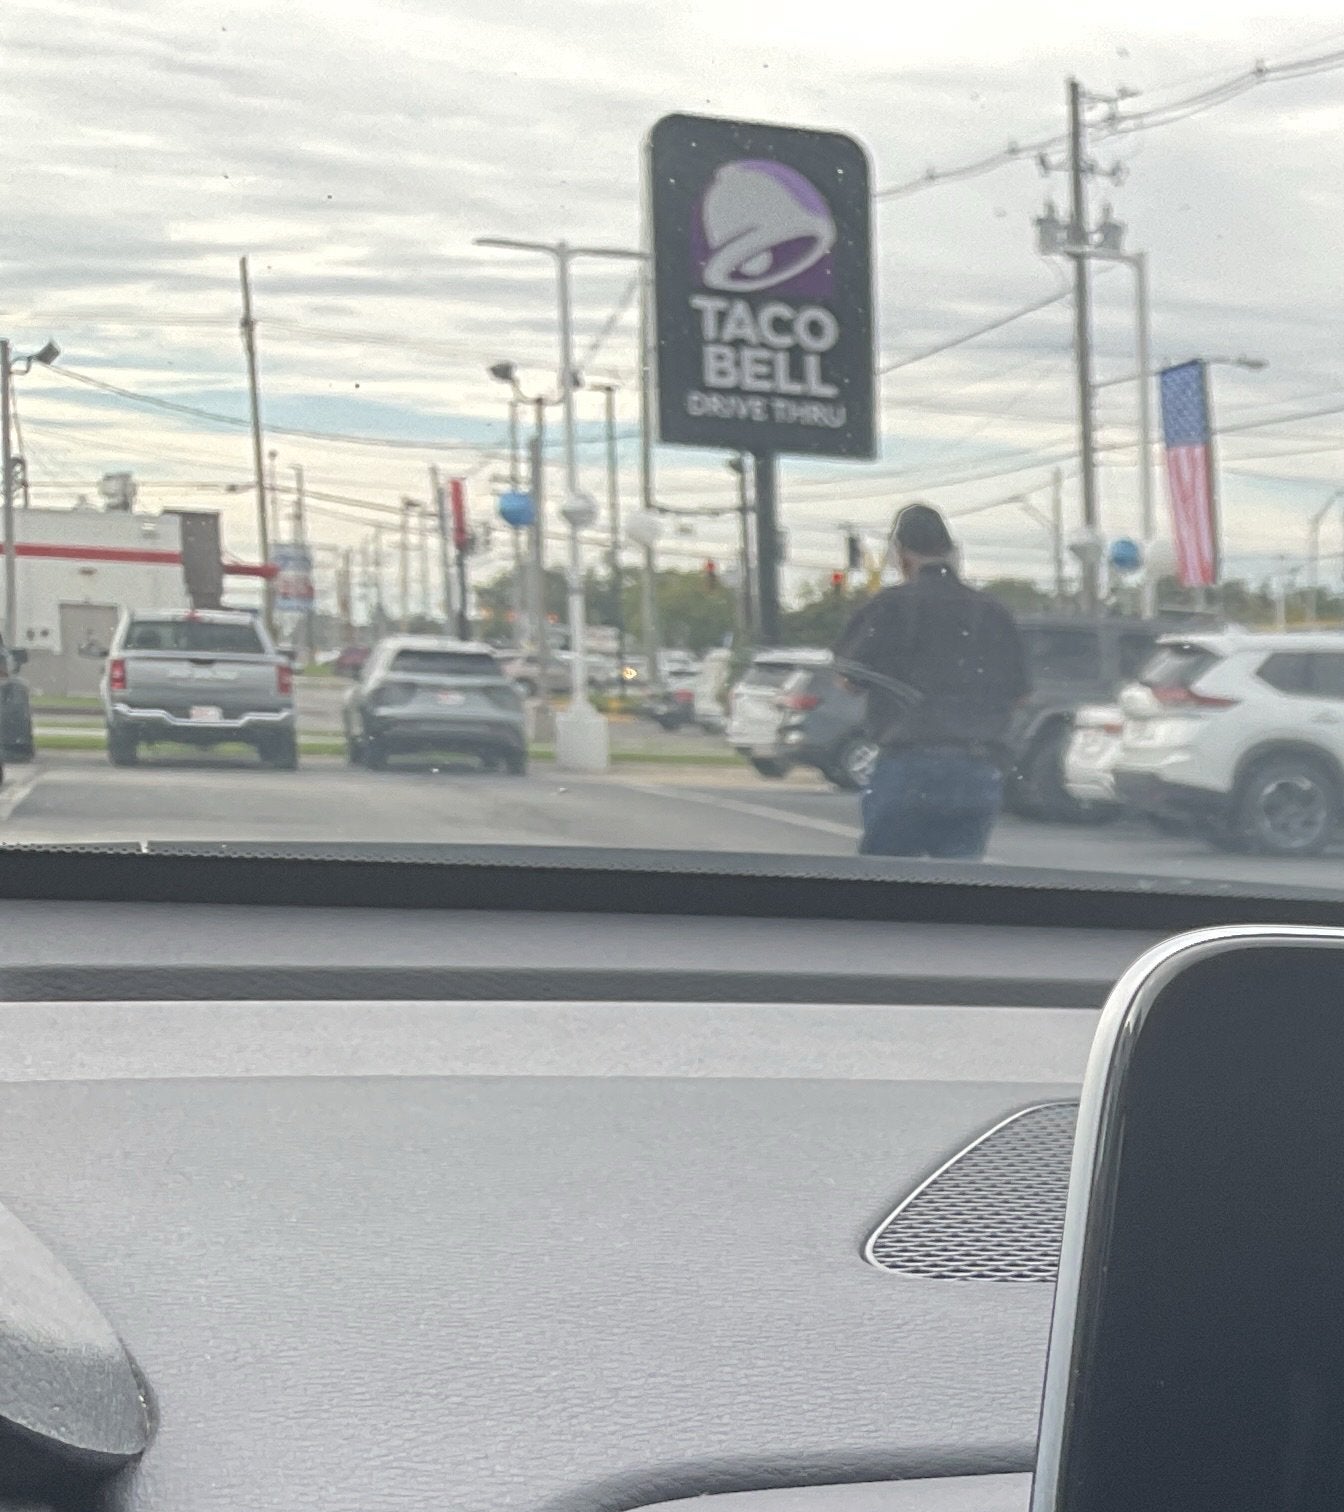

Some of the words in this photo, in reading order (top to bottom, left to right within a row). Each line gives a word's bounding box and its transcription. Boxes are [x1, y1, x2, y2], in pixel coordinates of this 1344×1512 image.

[688, 294, 840, 353] TACO
[703, 342, 841, 398] BELL
[685, 389, 769, 422] DRIVE
[771, 397, 847, 428] THRU
